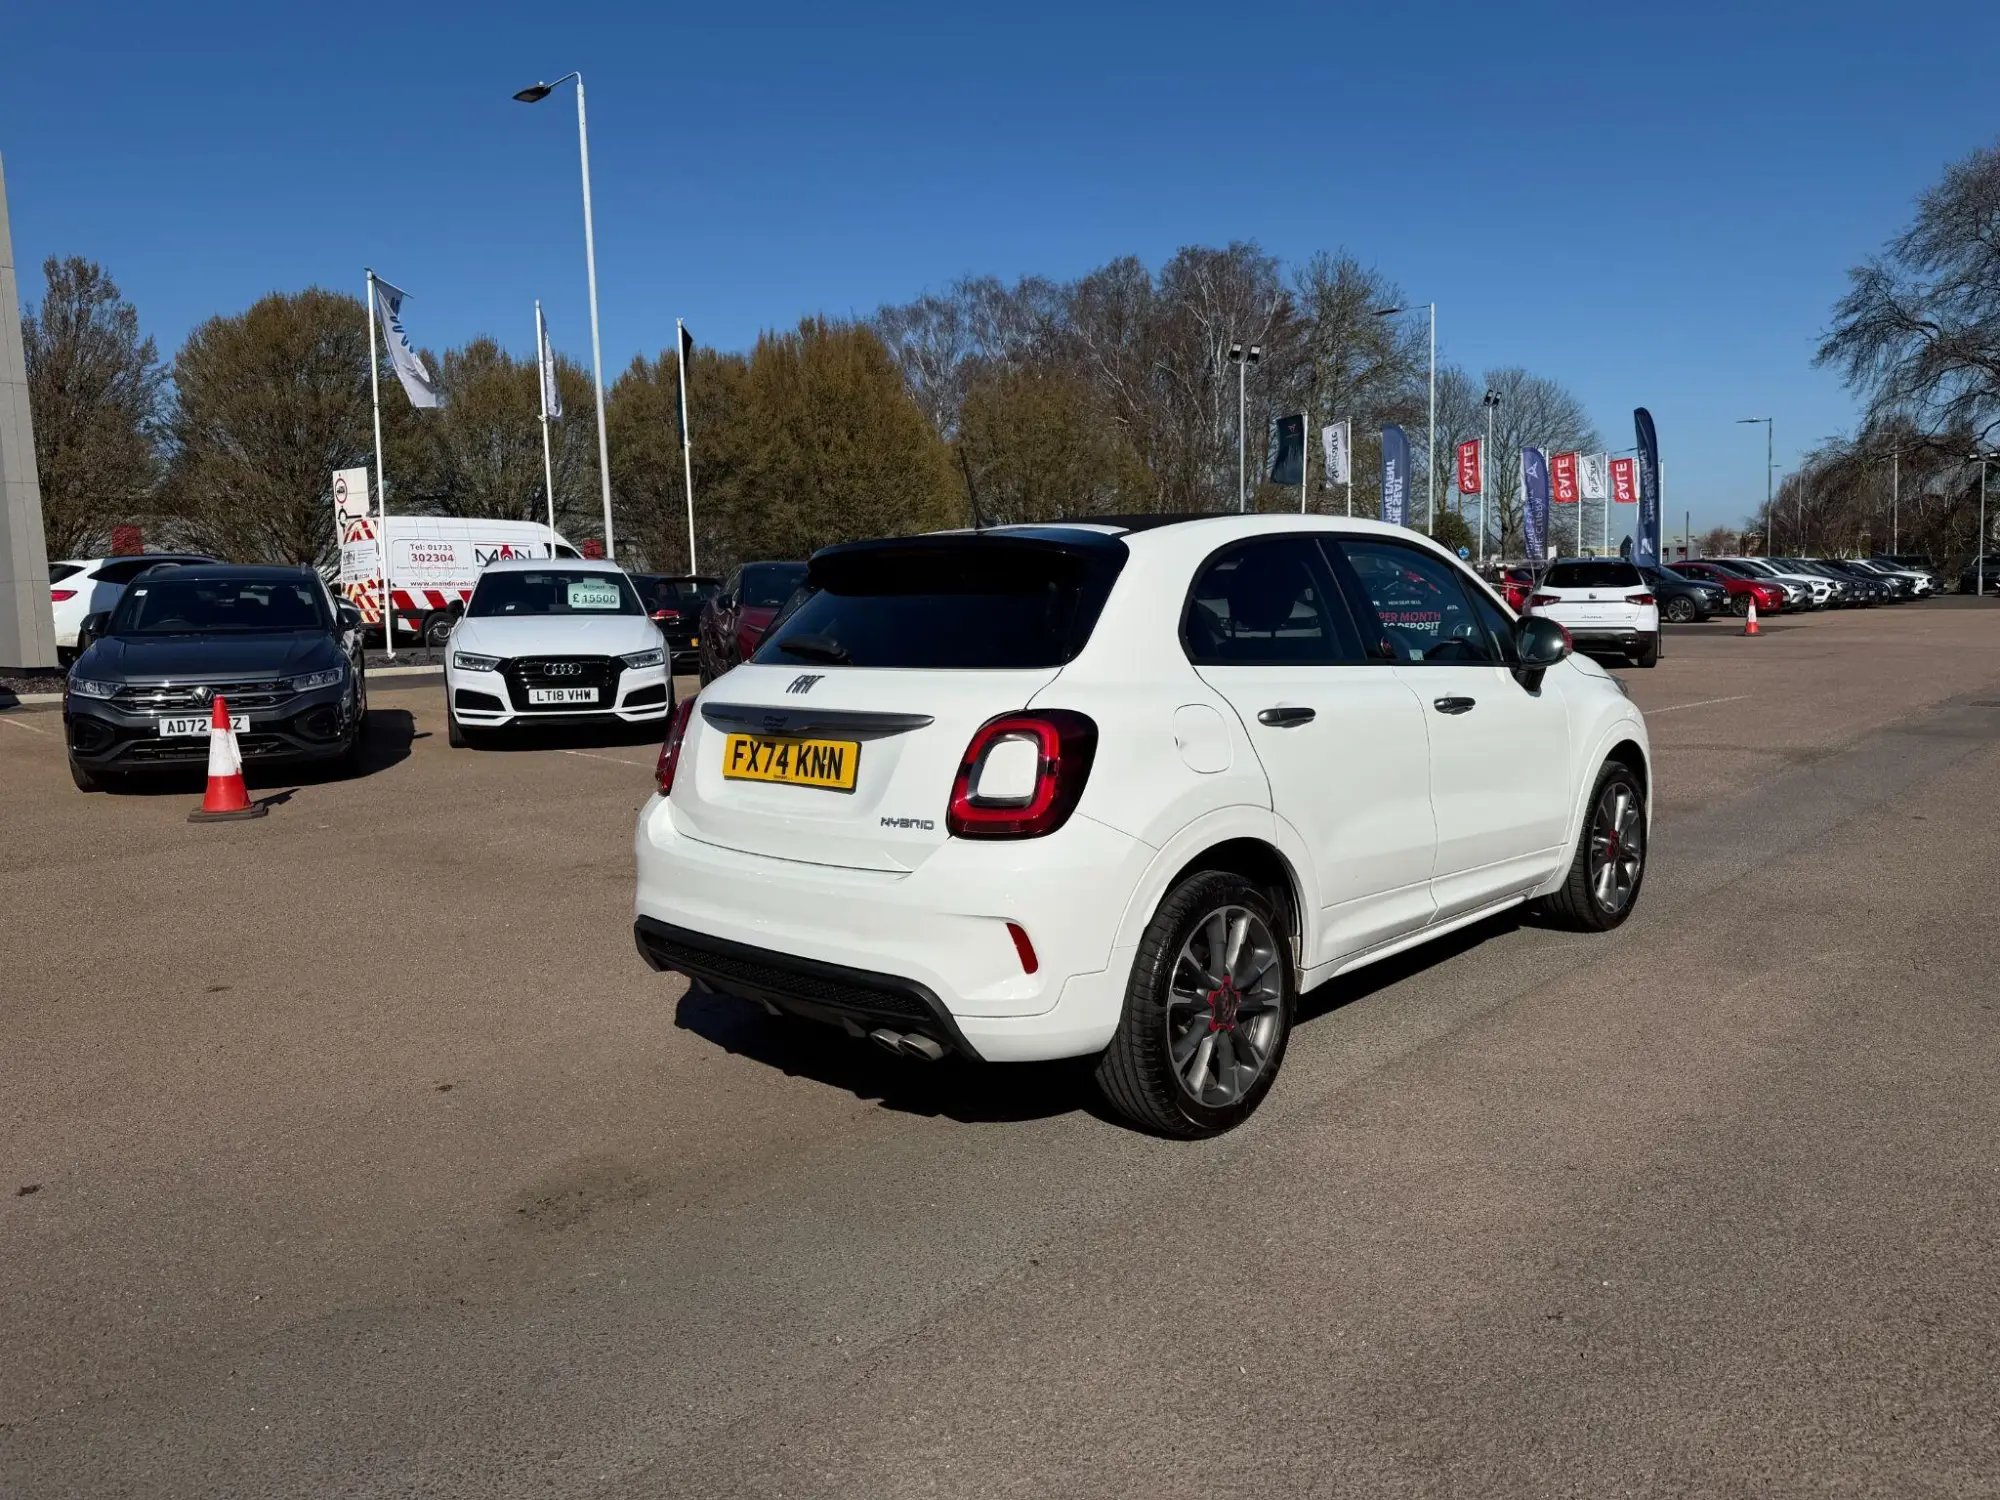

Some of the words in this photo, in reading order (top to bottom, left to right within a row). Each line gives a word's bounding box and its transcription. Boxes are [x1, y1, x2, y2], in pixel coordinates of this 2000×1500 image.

[411, 553, 454, 563] 302304
[583, 594, 616, 604] 15500
[1379, 612, 1398, 622] PER
[1400, 611, 1441, 622] MONTH
[536, 690, 564, 702] LT18
[567, 689, 591, 701] VHW
[166, 719, 207, 734] AD72
[731, 739, 789, 775] FX74
[795, 744, 844, 780] KNN
